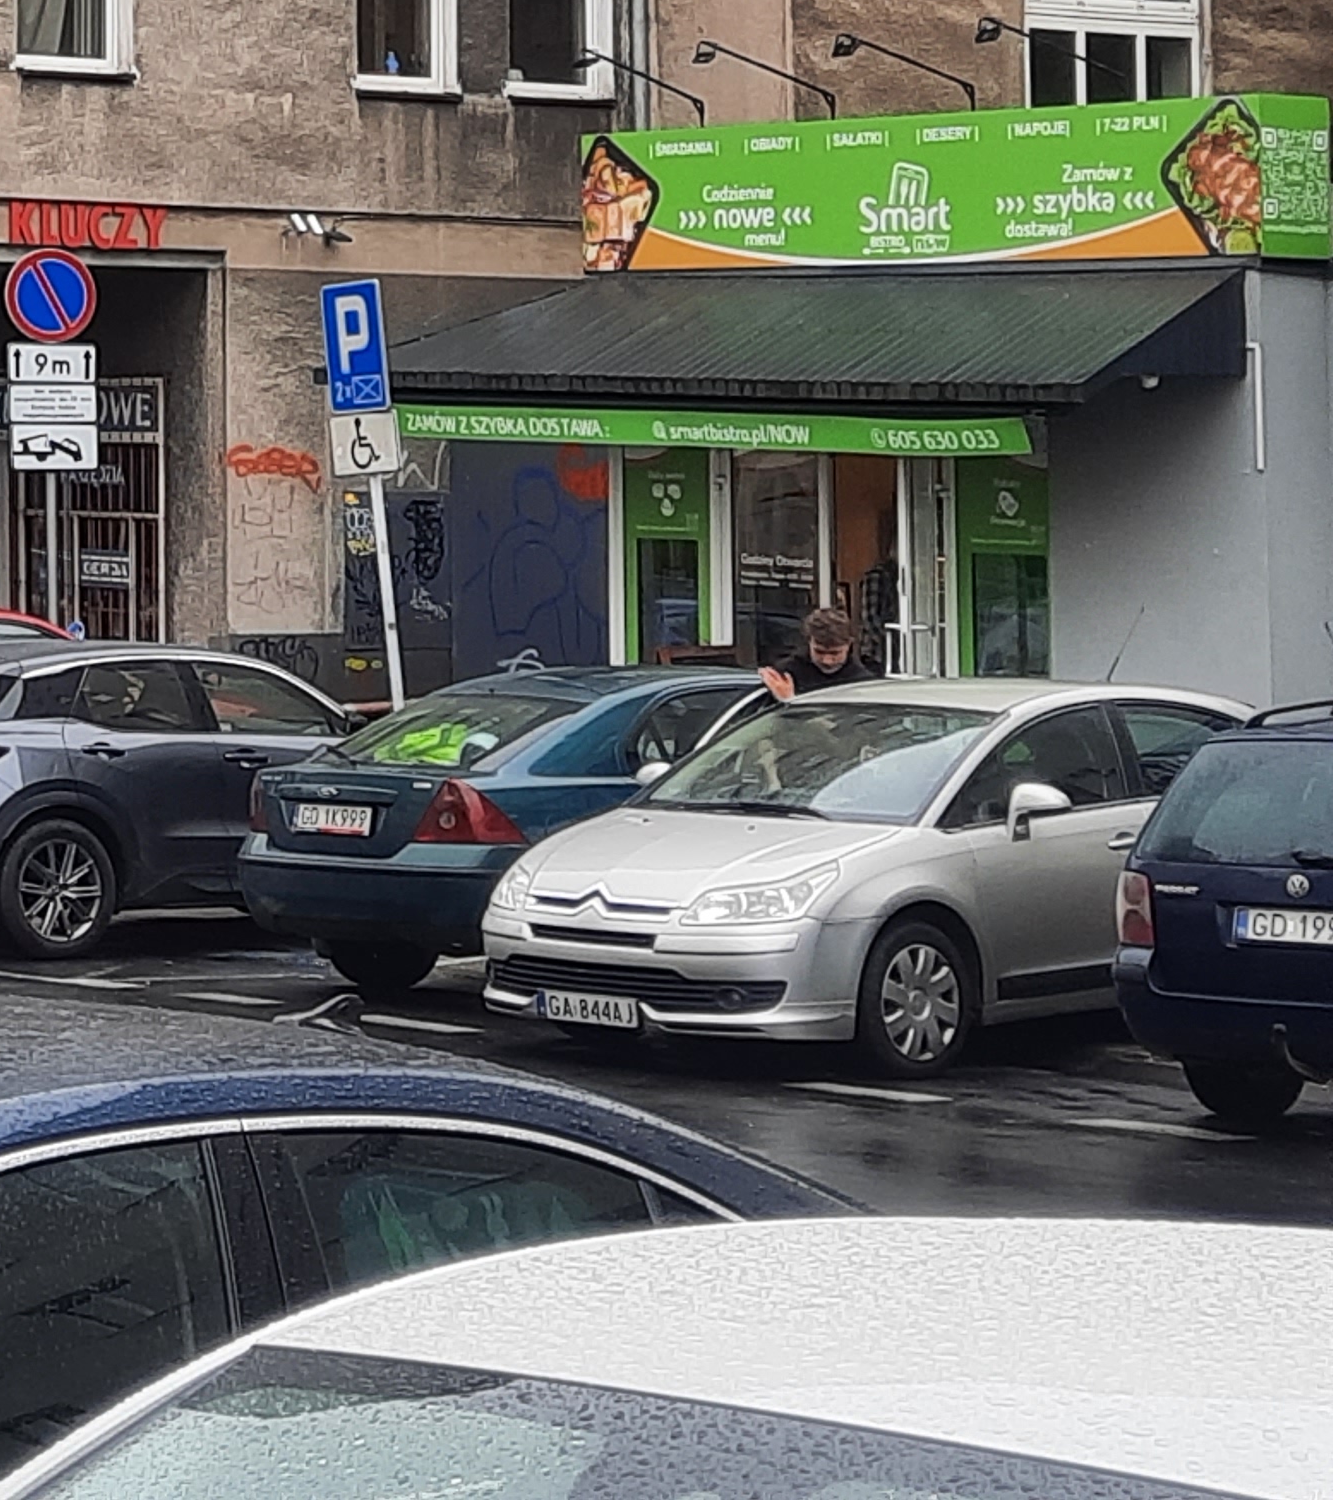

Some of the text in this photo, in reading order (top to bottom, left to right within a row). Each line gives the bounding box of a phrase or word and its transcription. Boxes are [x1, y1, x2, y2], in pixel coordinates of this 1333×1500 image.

[750, 137, 794, 151] OBIADY
[833, 131, 883, 147] SAŁATKI
[922, 127, 973, 142] DESERY
[1014, 119, 1067, 137] NAPOJE
[1133, 115, 1160, 131] PLN
[1062, 162, 1133, 183] Zamów z
[702, 183, 775, 202] Codziennie
[7, 200, 168, 250] KLUCZY
[713, 207, 775, 229] nowe
[859, 197, 951, 233] Smart
[745, 230, 785, 246] menu!
[335, 294, 369, 375] P
[406, 411, 455, 432] ZAMÓW
[458, 416, 469, 434] Z
[887, 430, 920, 450] 605
[922, 431, 957, 451] 630
[962, 429, 1000, 450] 033
[324, 808, 368, 828] 1K999
[1252, 912, 1288, 938] GD
[548, 995, 633, 1025] GA 844AJ
